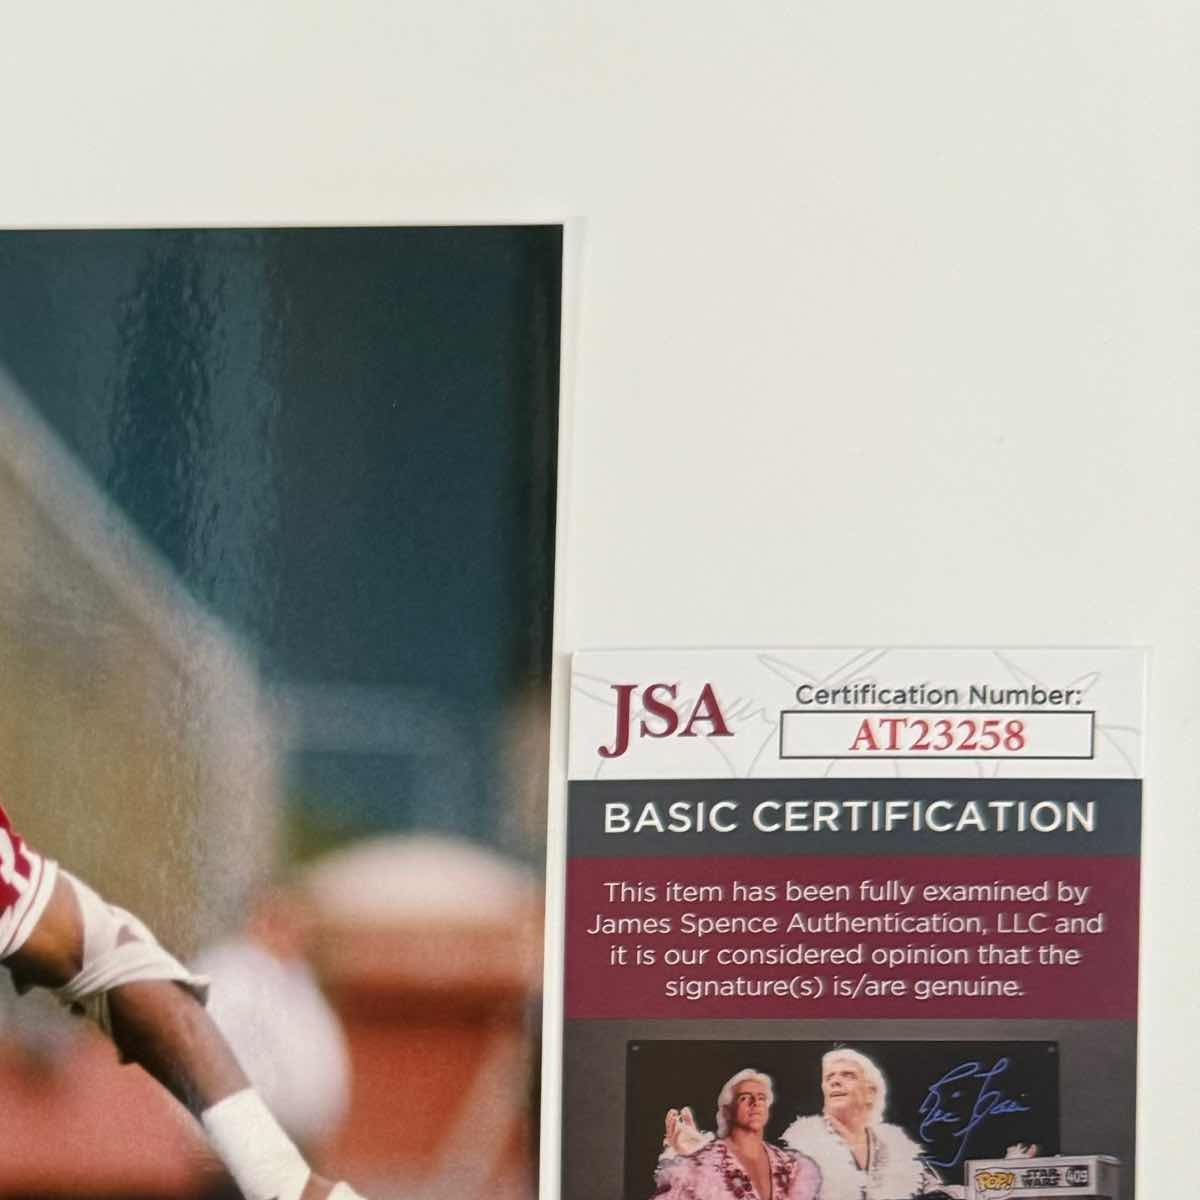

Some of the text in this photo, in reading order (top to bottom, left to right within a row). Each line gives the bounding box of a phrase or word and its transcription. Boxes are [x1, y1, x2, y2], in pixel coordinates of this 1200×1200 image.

[795, 683, 1082, 707] Certification Number:
[597, 683, 734, 759] JSA
[848, 718, 1026, 752] AT23258
[603, 800, 1095, 833] BASIC CERTIFICATION
[604, 879, 1089, 907] This item has been fully examined by
[586, 912, 1103, 939] James Spence Authentication, LLC and
[610, 943, 1079, 969] it is our considered opinion that the
[665, 973, 1024, 1001] signature(s) is/are genuine.
